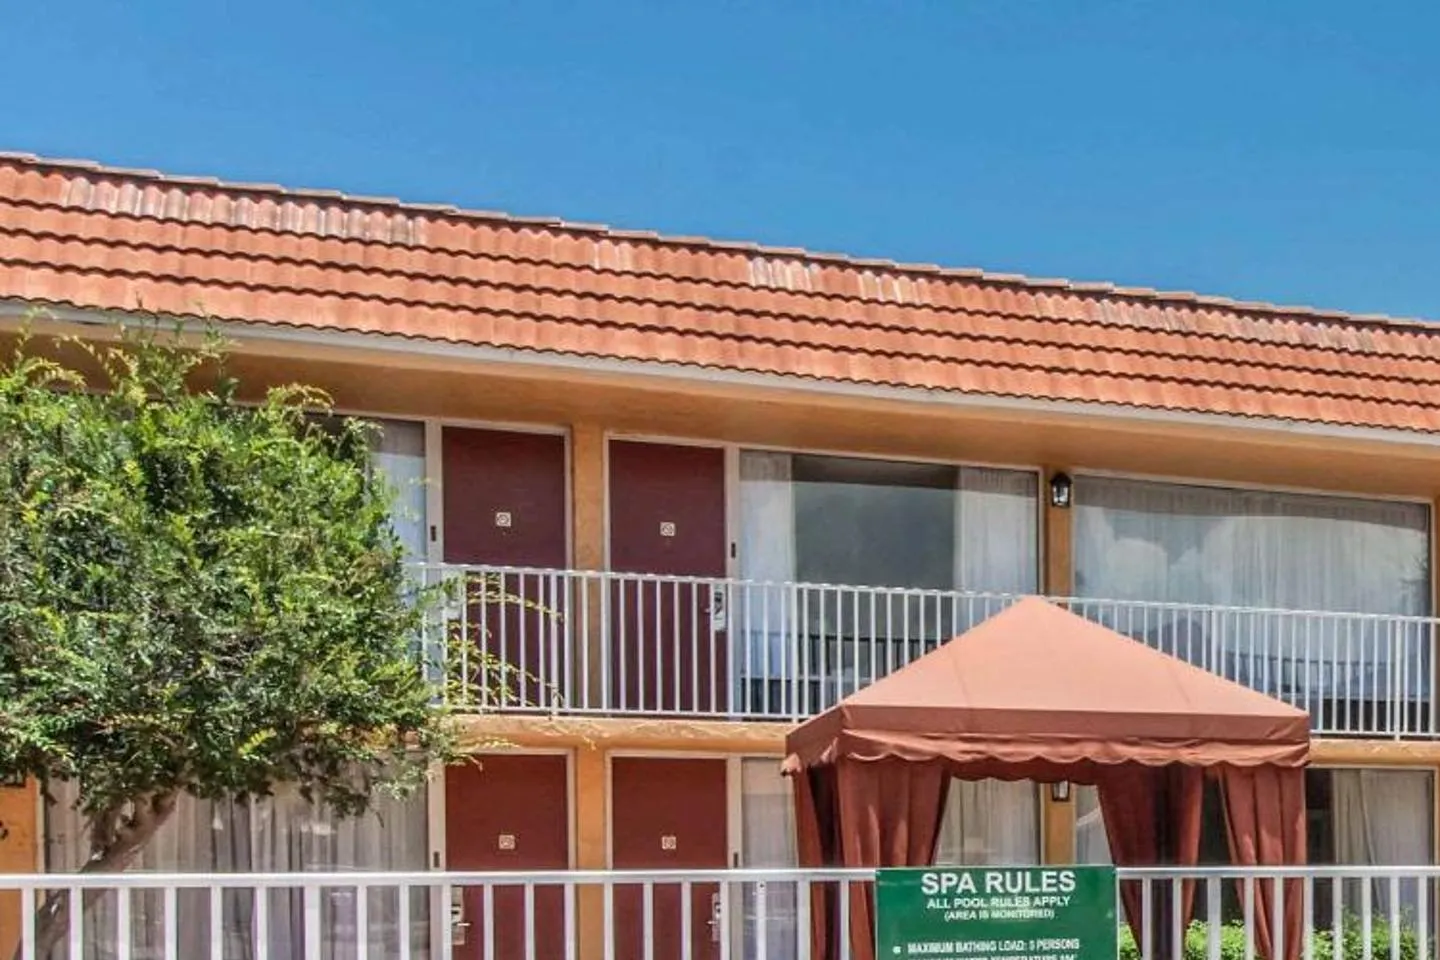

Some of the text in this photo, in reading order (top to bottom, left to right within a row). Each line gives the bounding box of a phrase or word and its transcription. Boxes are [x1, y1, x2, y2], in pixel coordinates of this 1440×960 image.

[921, 871, 1076, 894] SPA RULES
[927, 896, 1071, 909] ALL POOL RULES APPLY
[944, 909, 1055, 921] (AREA IS MONITORED)
[908, 942, 953, 953] MAXIMUM
[956, 941, 996, 953] BATHING
[998, 940, 1027, 951] LOAD:
[1036, 938, 1080, 950] PERSONS
